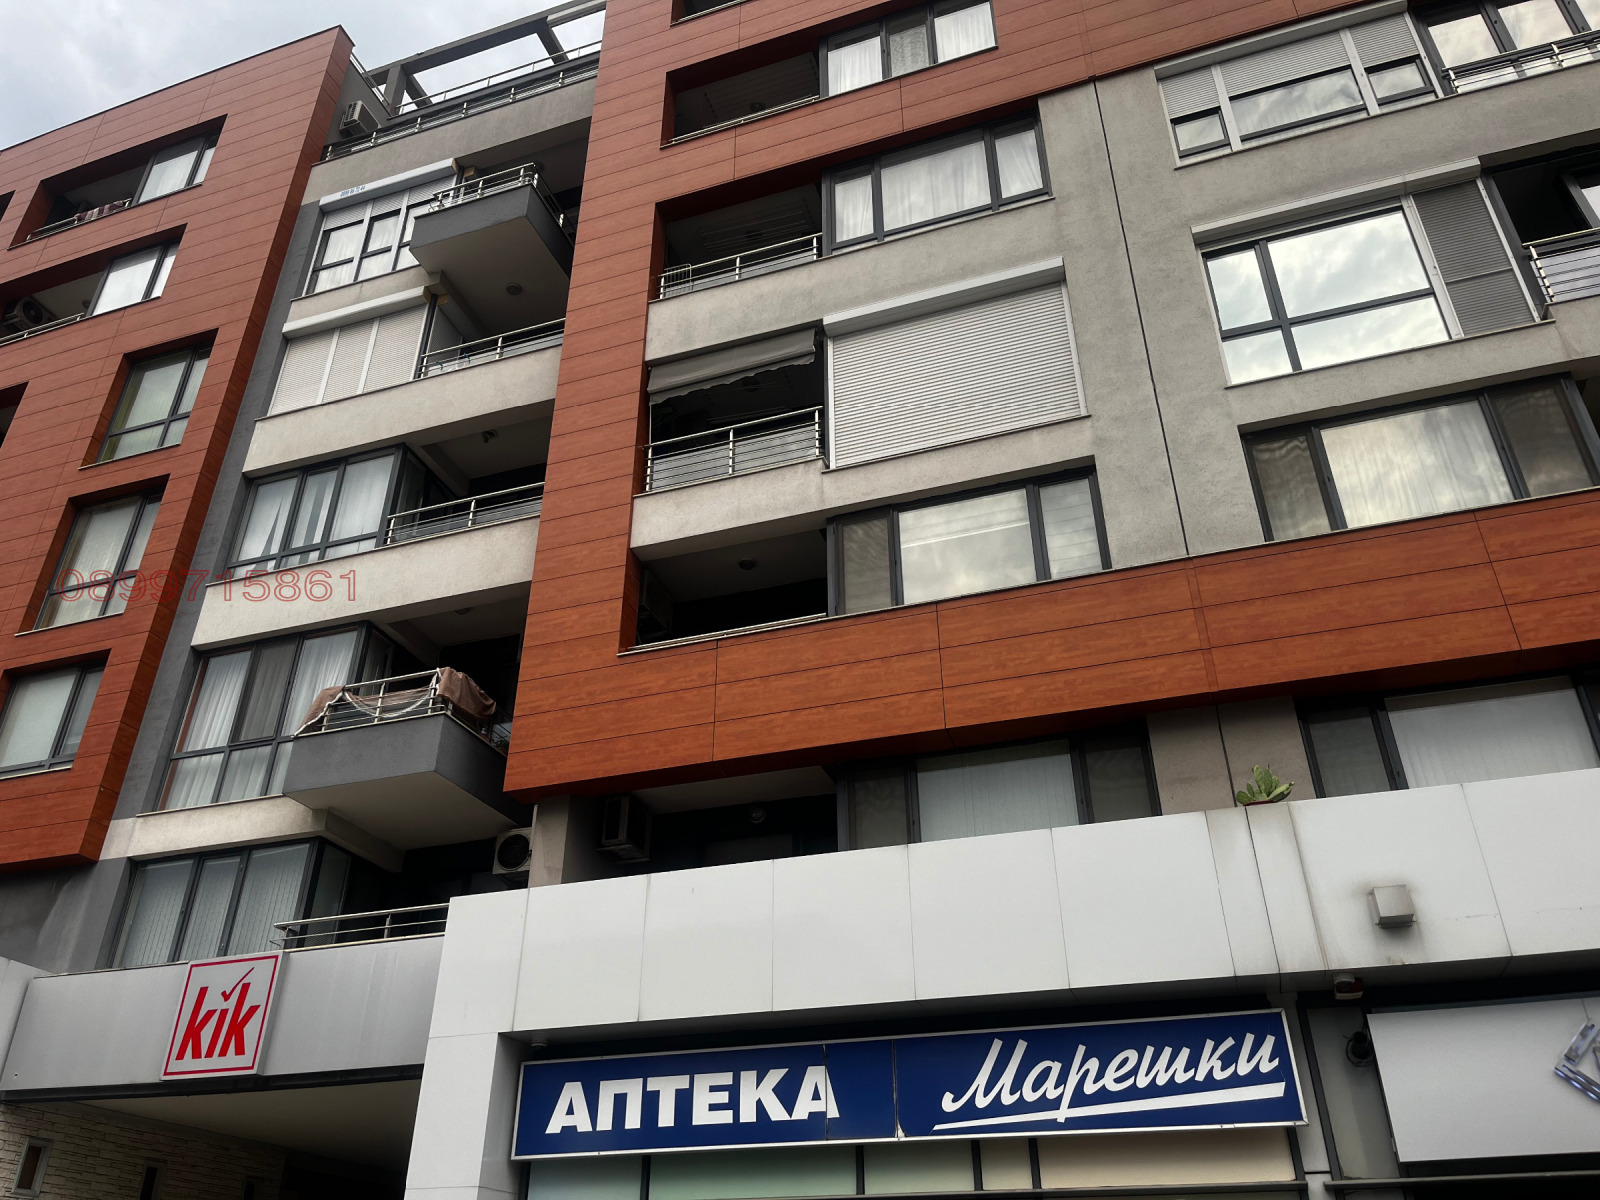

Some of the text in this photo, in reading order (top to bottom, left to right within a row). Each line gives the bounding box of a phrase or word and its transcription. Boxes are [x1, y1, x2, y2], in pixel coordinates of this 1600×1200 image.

[175, 967, 261, 1060] kik
[545, 1032, 1280, 1134] АПТЕКА Марешки
